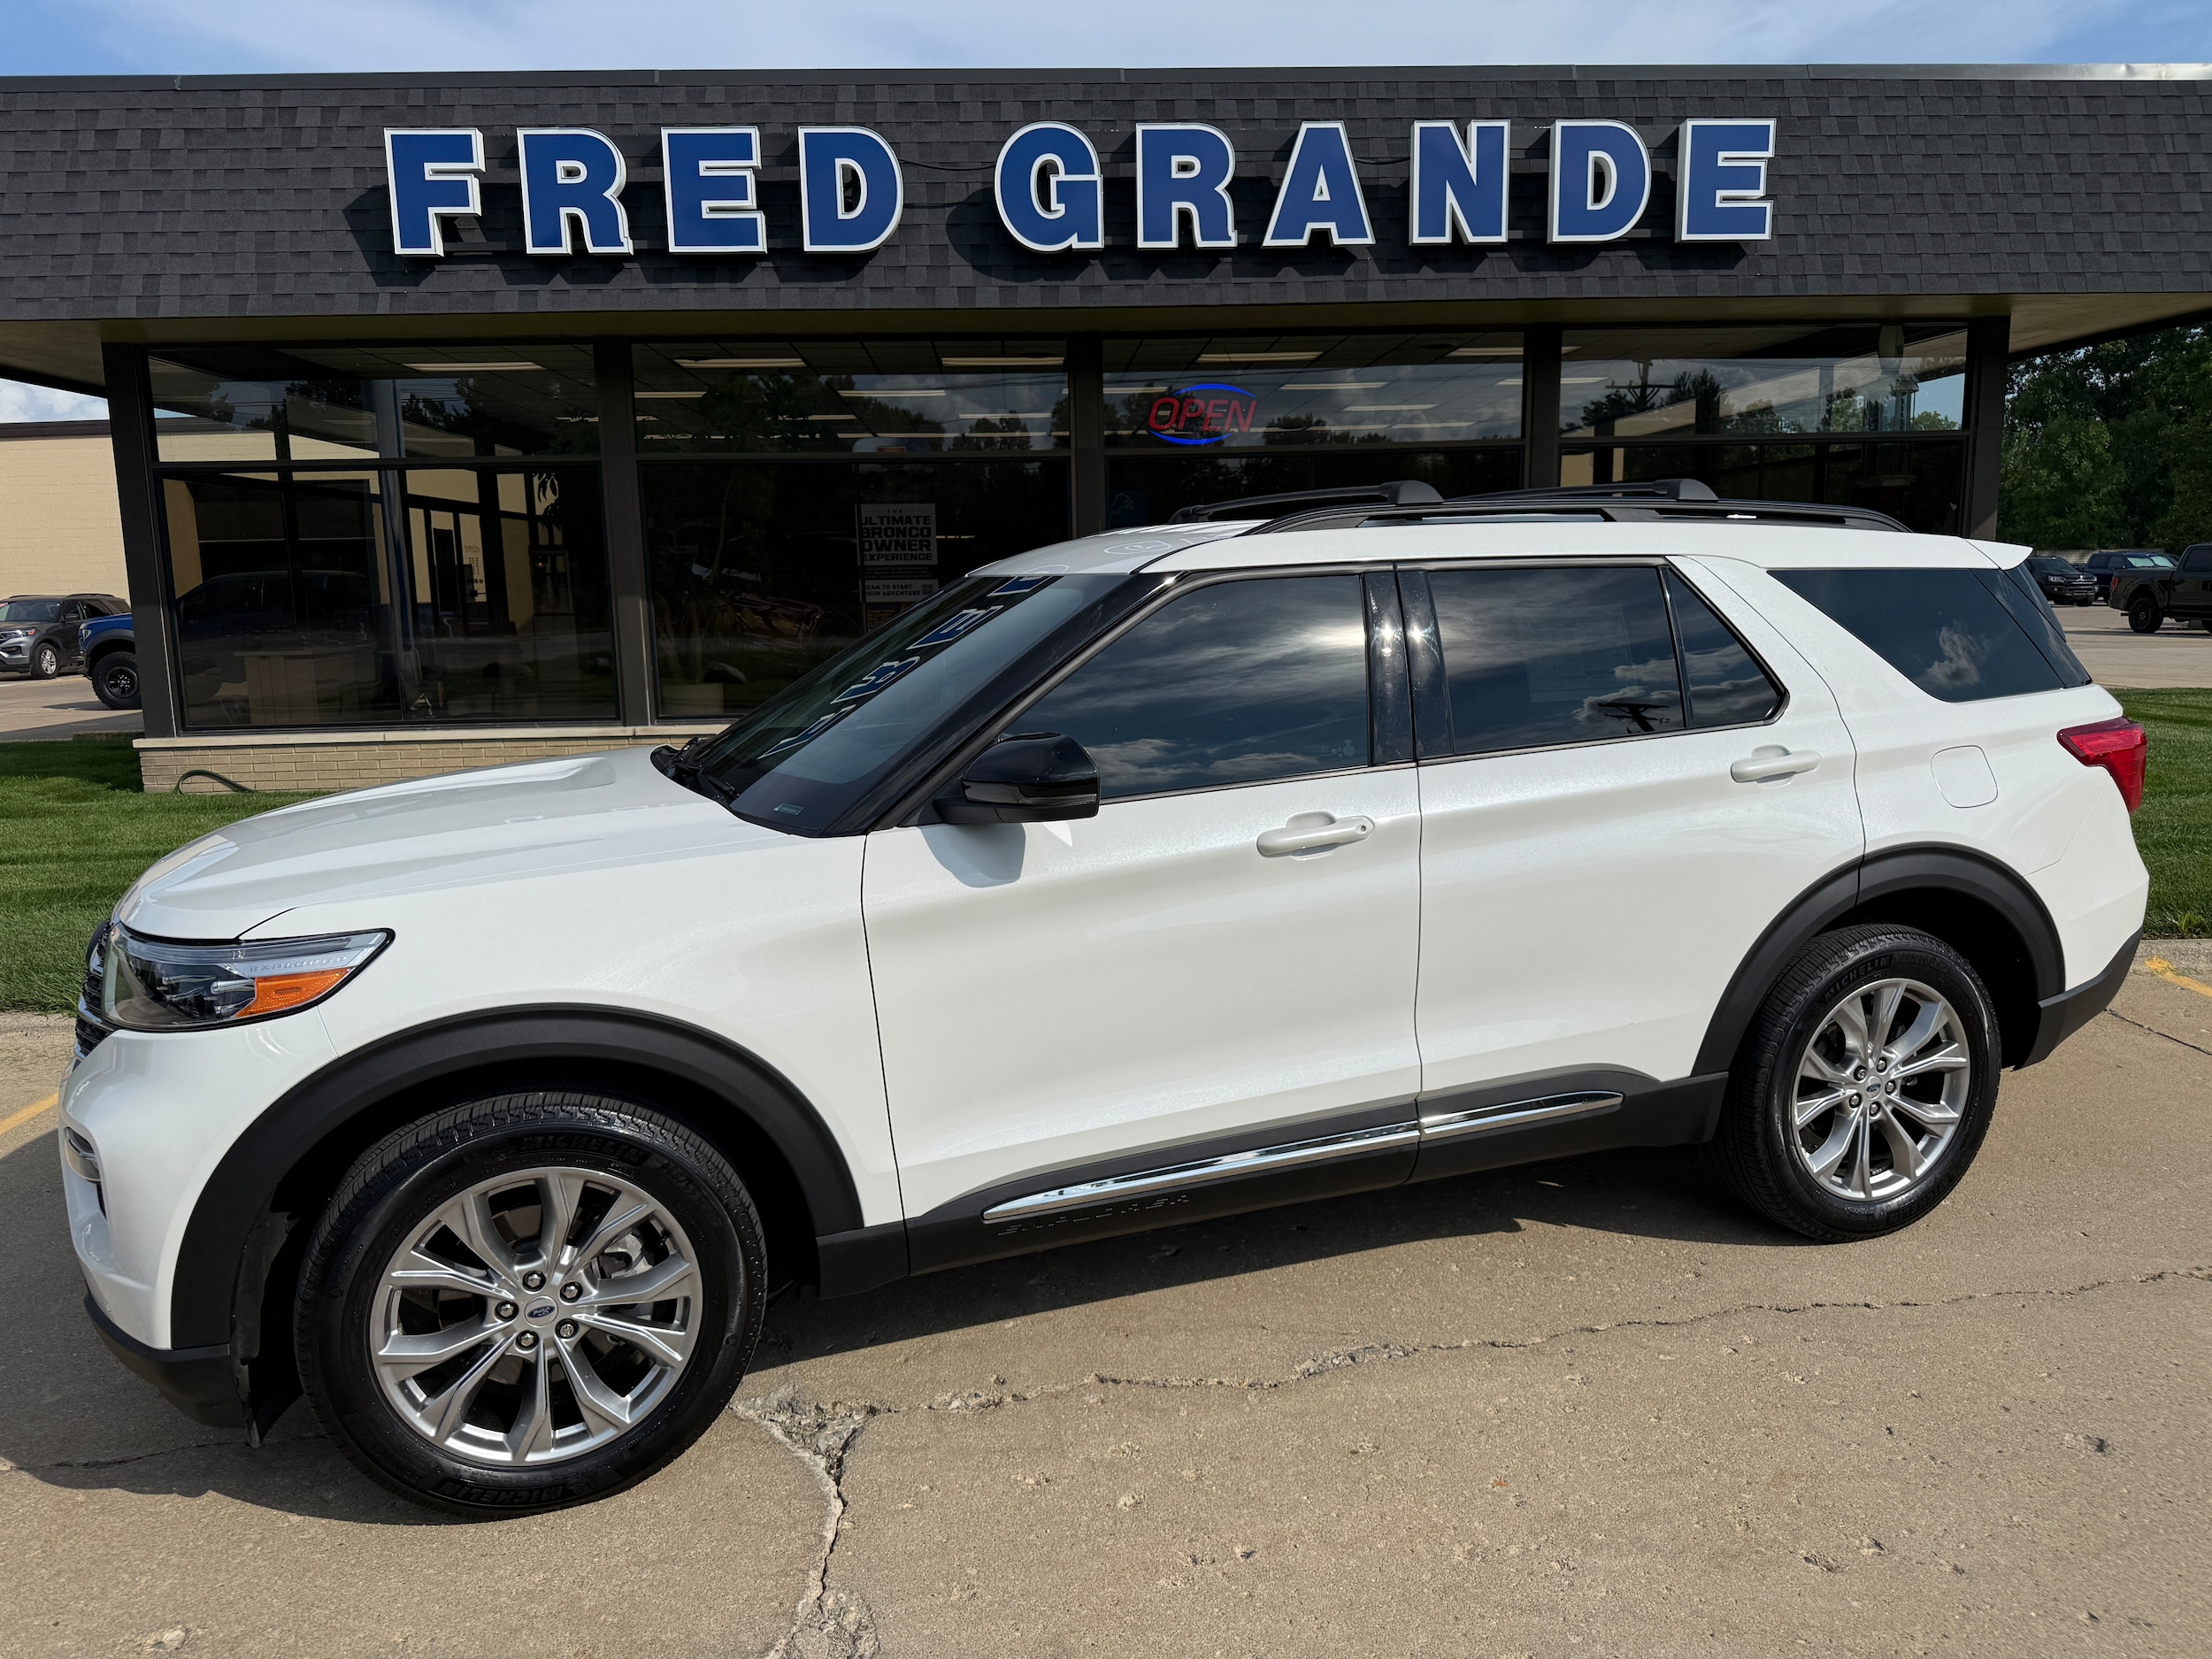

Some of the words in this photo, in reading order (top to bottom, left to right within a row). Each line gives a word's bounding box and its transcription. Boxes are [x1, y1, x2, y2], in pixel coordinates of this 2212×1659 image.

[383, 126, 904, 256] FRED
[993, 118, 1778, 253] GRANDE
[1148, 396, 1257, 433] OPEN
[862, 526, 932, 539] BRONCO
[863, 539, 932, 552] OWNER
[864, 553, 933, 562] EXPERIENCE
[519, 1133, 647, 1164] MICHELIN
